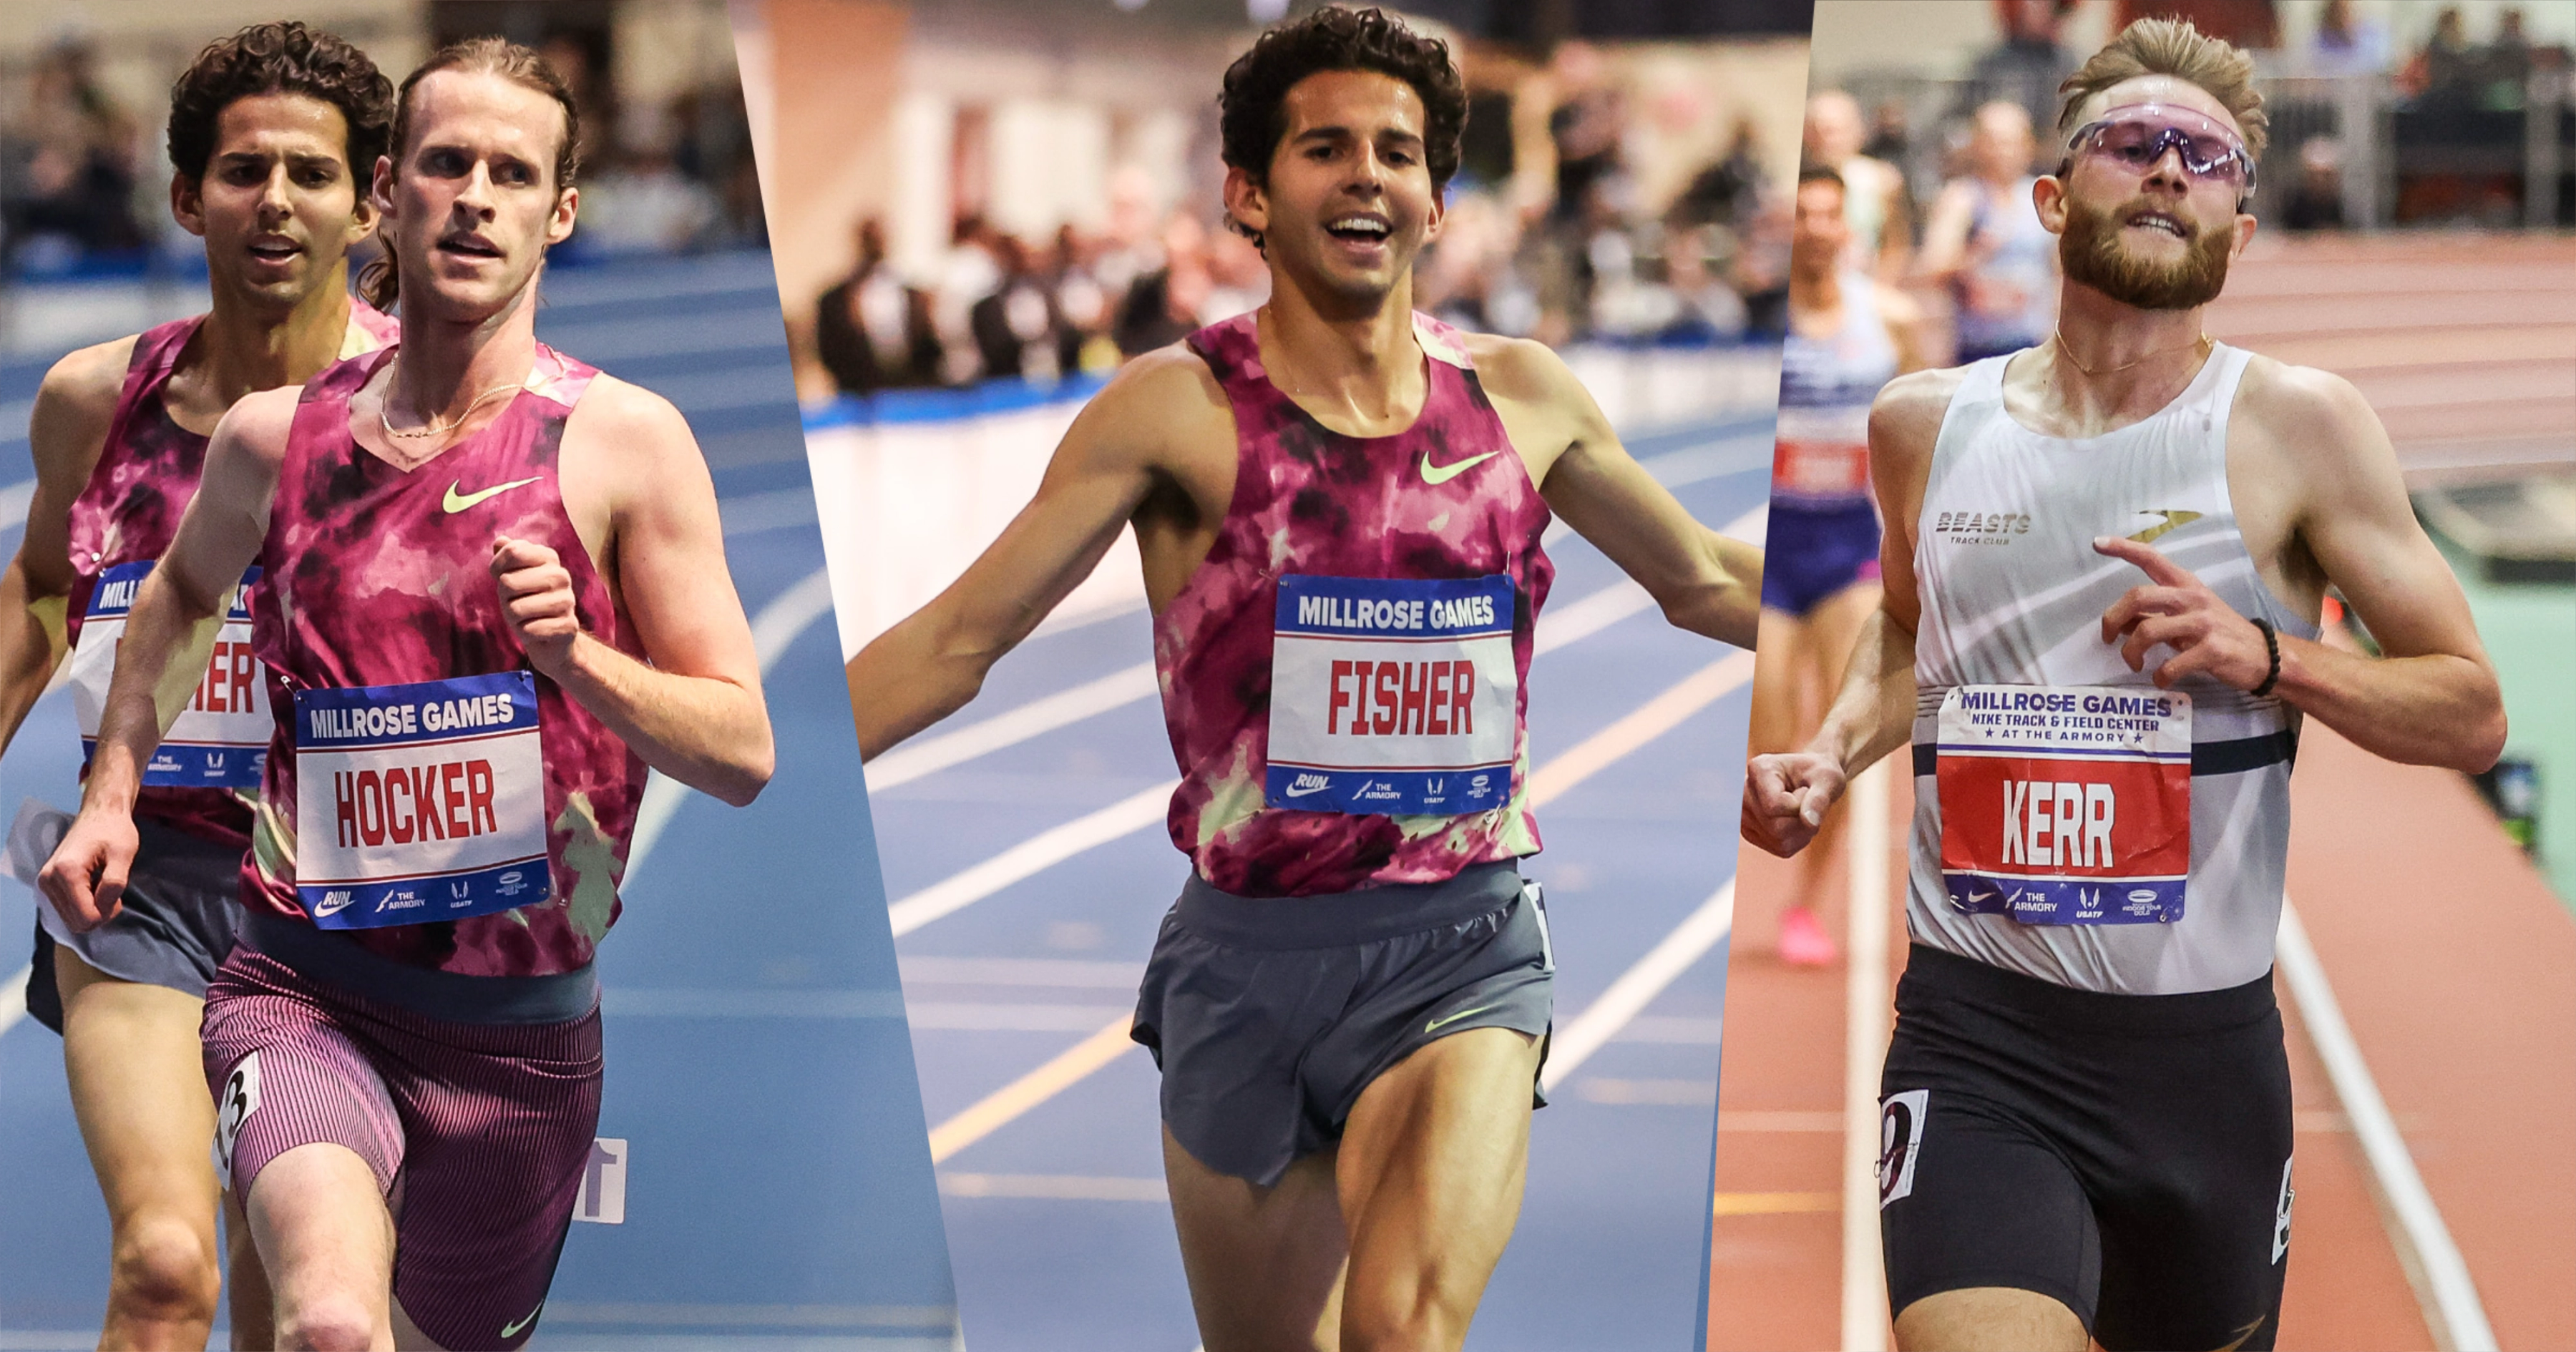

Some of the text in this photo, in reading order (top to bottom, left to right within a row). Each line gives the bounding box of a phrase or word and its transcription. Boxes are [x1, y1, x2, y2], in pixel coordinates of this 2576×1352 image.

[1936, 512, 2030, 534] BEASTS
[1298, 595, 1494, 630] MILLROSE GAMES
[1328, 660, 1475, 735] FISHER
[1961, 692, 2172, 717] MILLROSE GAMES
[311, 693, 514, 738] MILLROSE GAMES
[1972, 713, 2159, 731] NIKE TRACK & FIELD CENTER
[2001, 729, 2124, 742] AT THE ARMORY
[1295, 773, 1330, 788] RUN
[334, 758, 497, 848] HOCKER
[1365, 791, 1401, 800] ARMORY
[2001, 780, 2114, 868] KERR
[323, 891, 351, 906] RUN
[389, 898, 426, 910] ARMORY
[2026, 892, 2046, 902] THE
[2014, 901, 2057, 912] ARMORY
